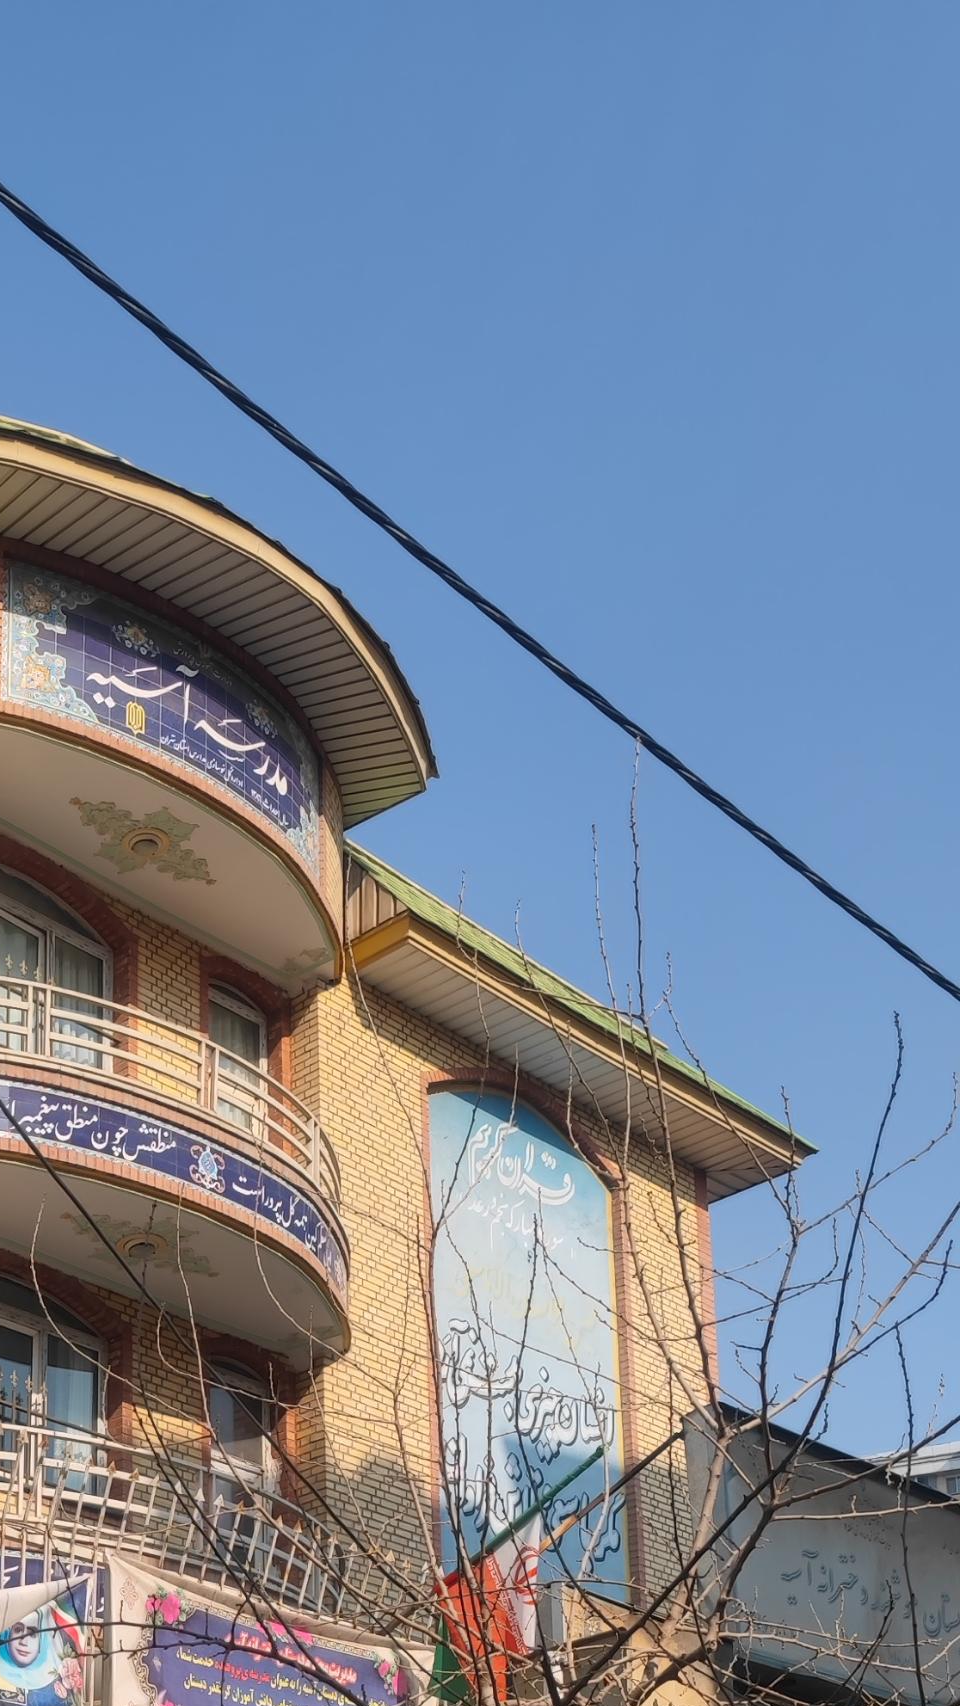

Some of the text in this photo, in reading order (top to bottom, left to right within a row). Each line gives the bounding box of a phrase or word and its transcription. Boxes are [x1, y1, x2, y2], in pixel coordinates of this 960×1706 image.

[55, 1103, 99, 1141] منطق
[91, 1125, 129, 1157] چون
[122, 1123, 177, 1161] منطقش
